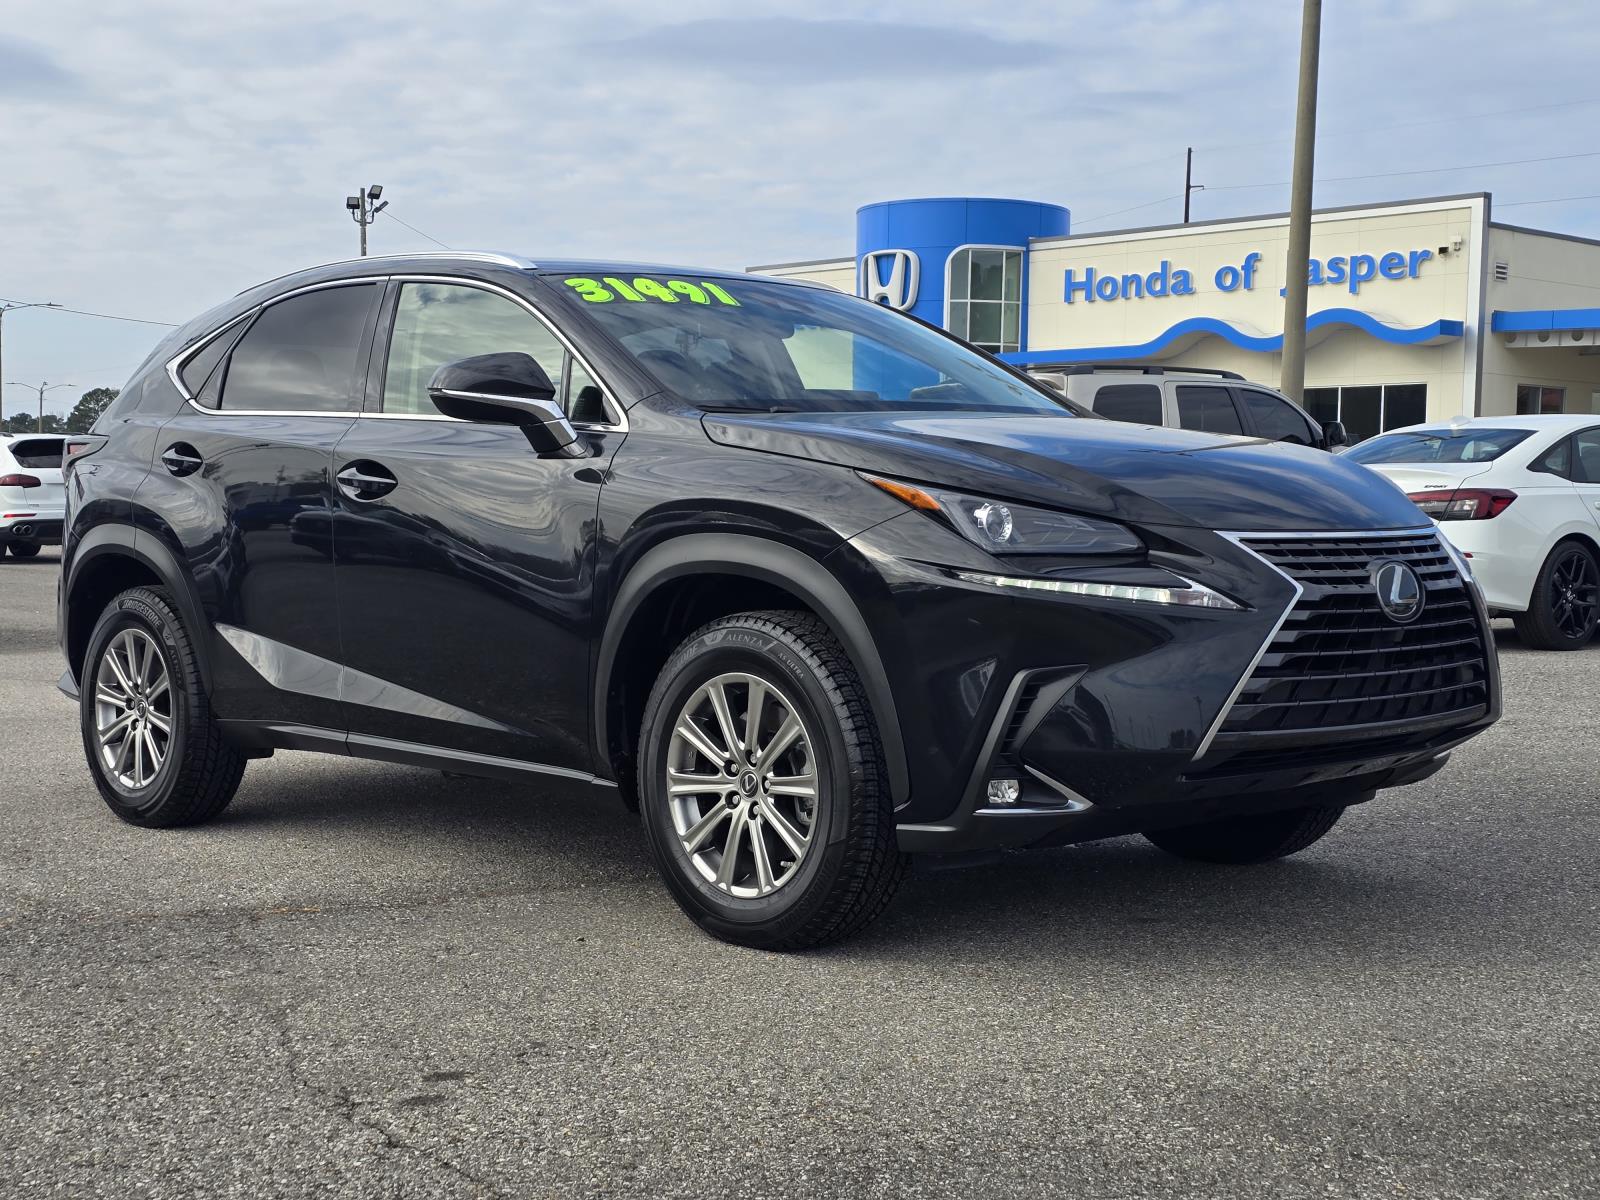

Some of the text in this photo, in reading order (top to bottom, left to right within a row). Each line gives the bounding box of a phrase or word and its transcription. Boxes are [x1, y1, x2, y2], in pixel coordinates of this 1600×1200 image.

[564, 277, 741, 307] 31491
[1064, 249, 1433, 303] Honda of asper
[122, 599, 162, 627] BRIDGESTONE
[726, 633, 763, 647] ALENZA
[786, 659, 804, 679] ULTRA
